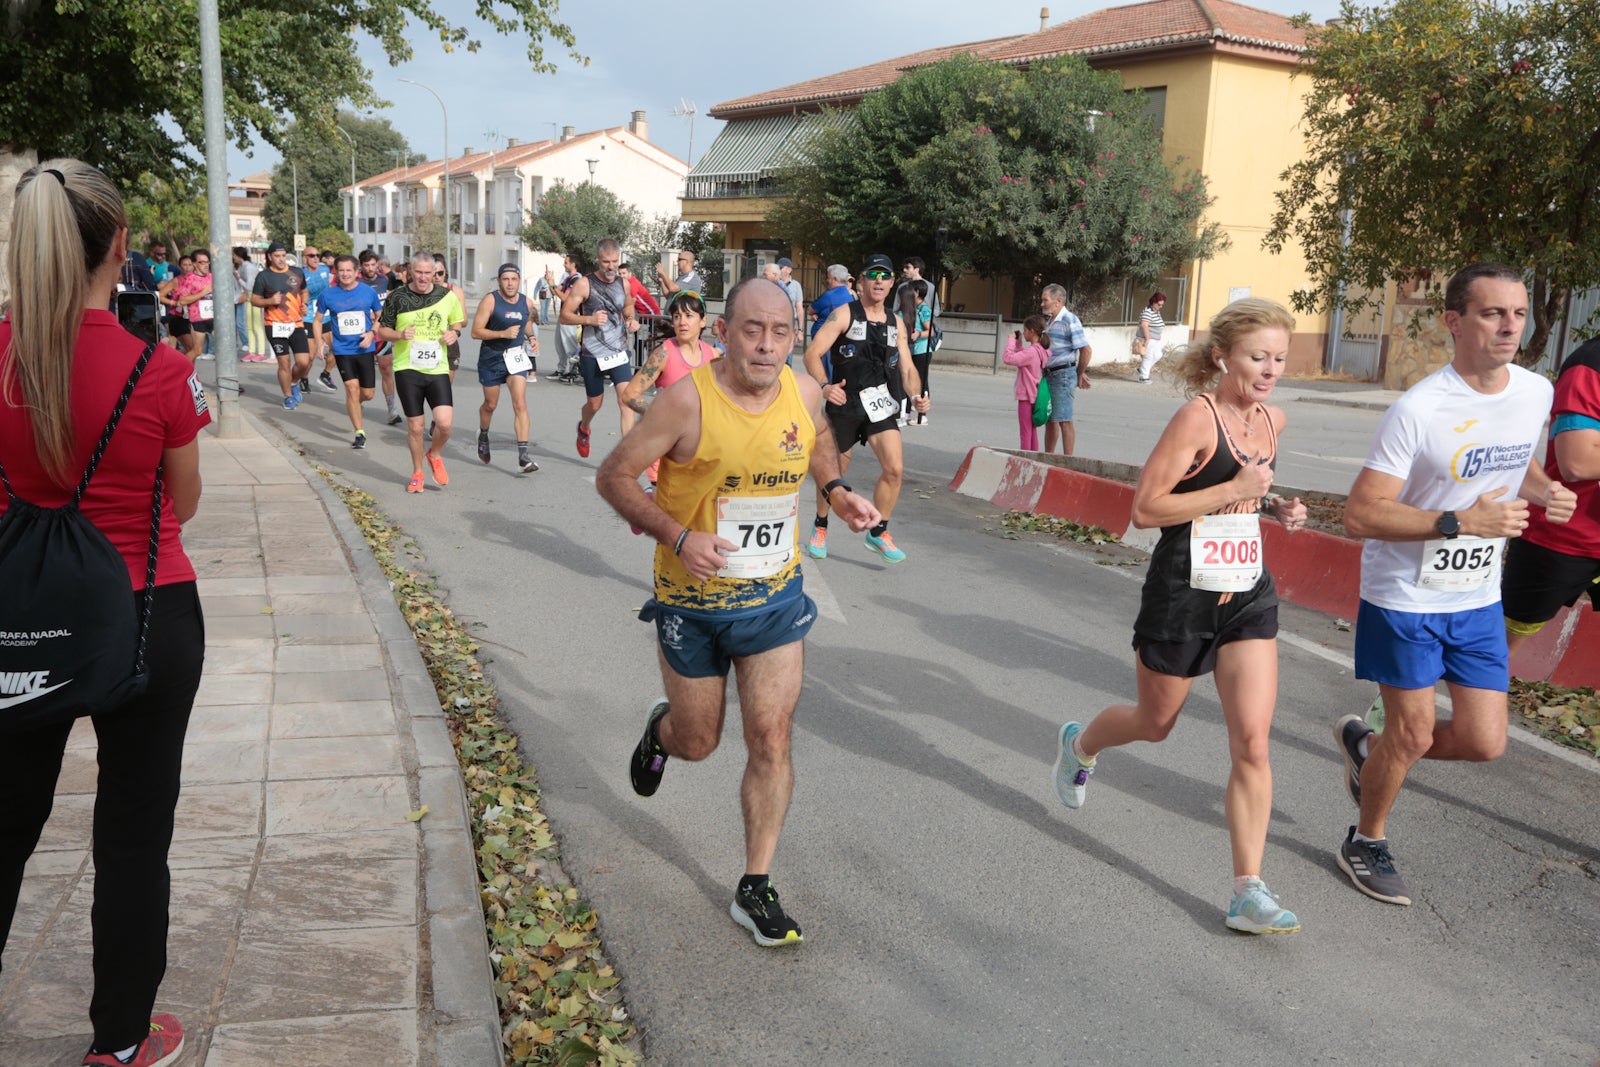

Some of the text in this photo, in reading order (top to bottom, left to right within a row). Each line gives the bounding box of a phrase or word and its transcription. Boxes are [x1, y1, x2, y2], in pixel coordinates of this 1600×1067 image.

[343, 318, 360, 327] 683
[277, 325, 292, 333] 364
[417, 350, 437, 360] 254
[1494, 442, 1532, 454] Nocturna
[1493, 450, 1531, 463] VALENCIA
[1482, 462, 1528, 473] mediolanum
[738, 522, 785, 548] 767
[1202, 540, 1259, 565] 2008
[1433, 545, 1495, 571] 3052
[0, 629, 72, 640] RAFA NADAL
[0, 670, 50, 694] NIKE
